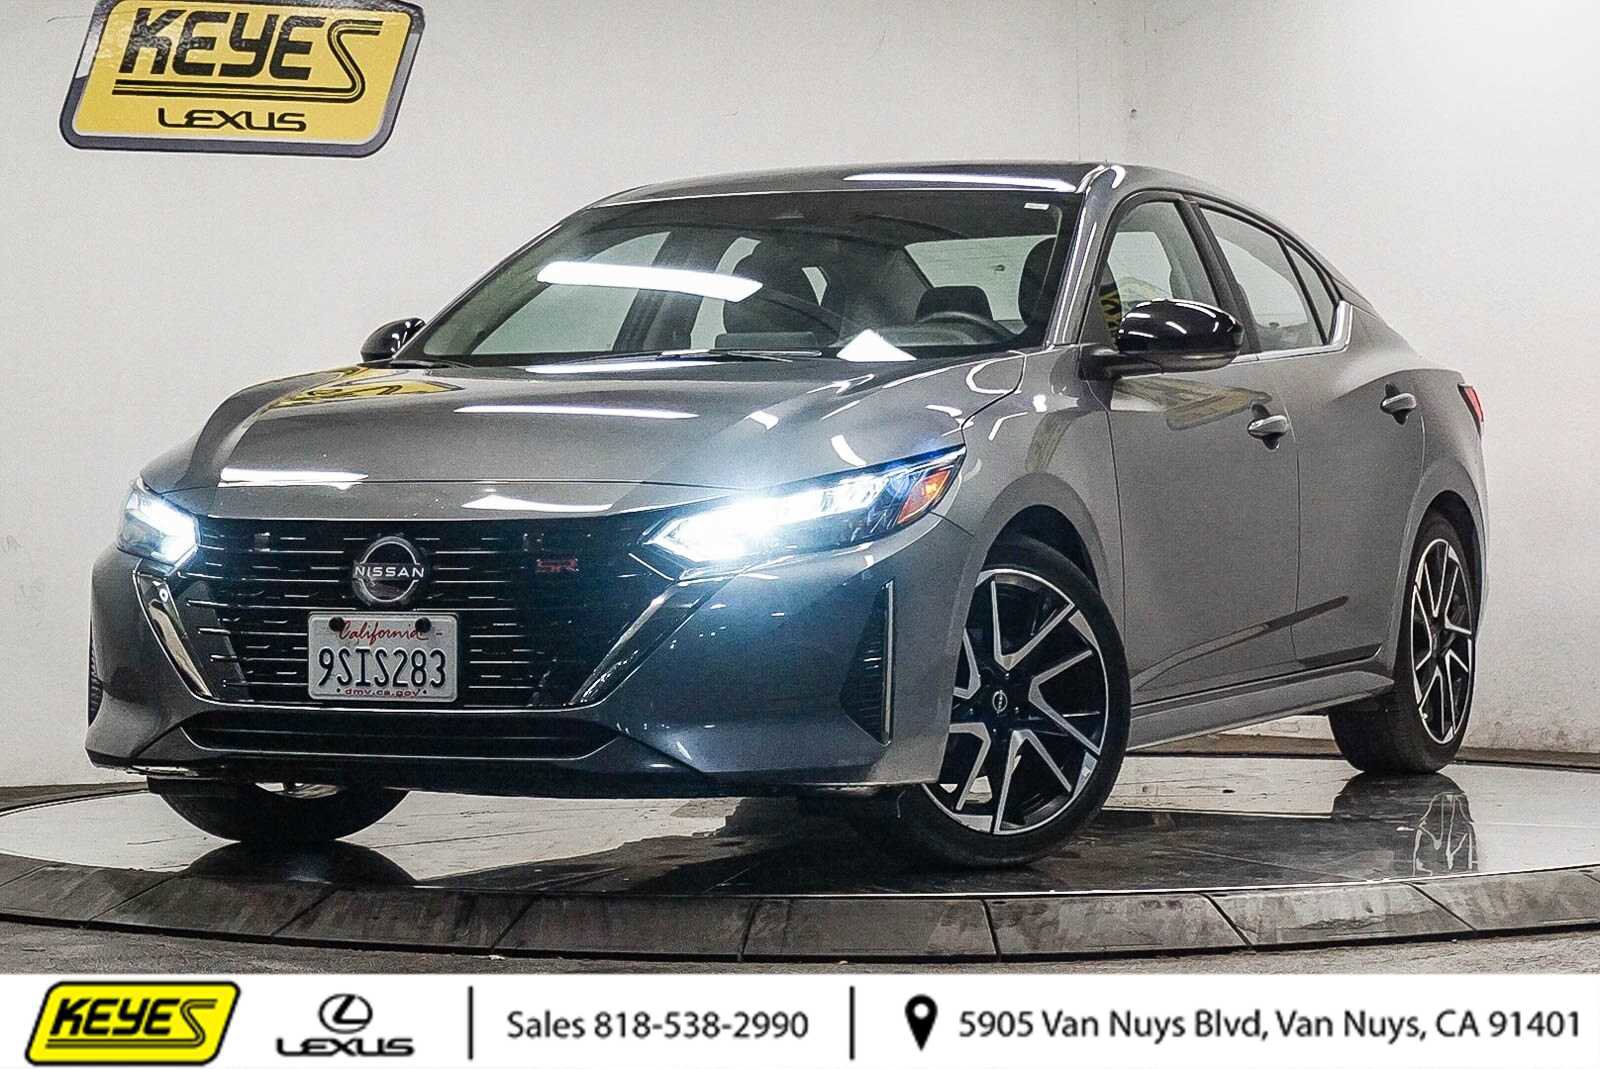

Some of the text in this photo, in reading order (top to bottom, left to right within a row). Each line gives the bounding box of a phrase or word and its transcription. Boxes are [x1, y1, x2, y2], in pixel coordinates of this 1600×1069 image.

[112, 7, 384, 103] KEYES
[157, 107, 306, 132] LEXUS
[354, 565, 425, 579] NISSAN
[338, 619, 429, 646] California
[318, 647, 446, 687] 9SIS283
[344, 687, 420, 698] dmv.ca.gov
